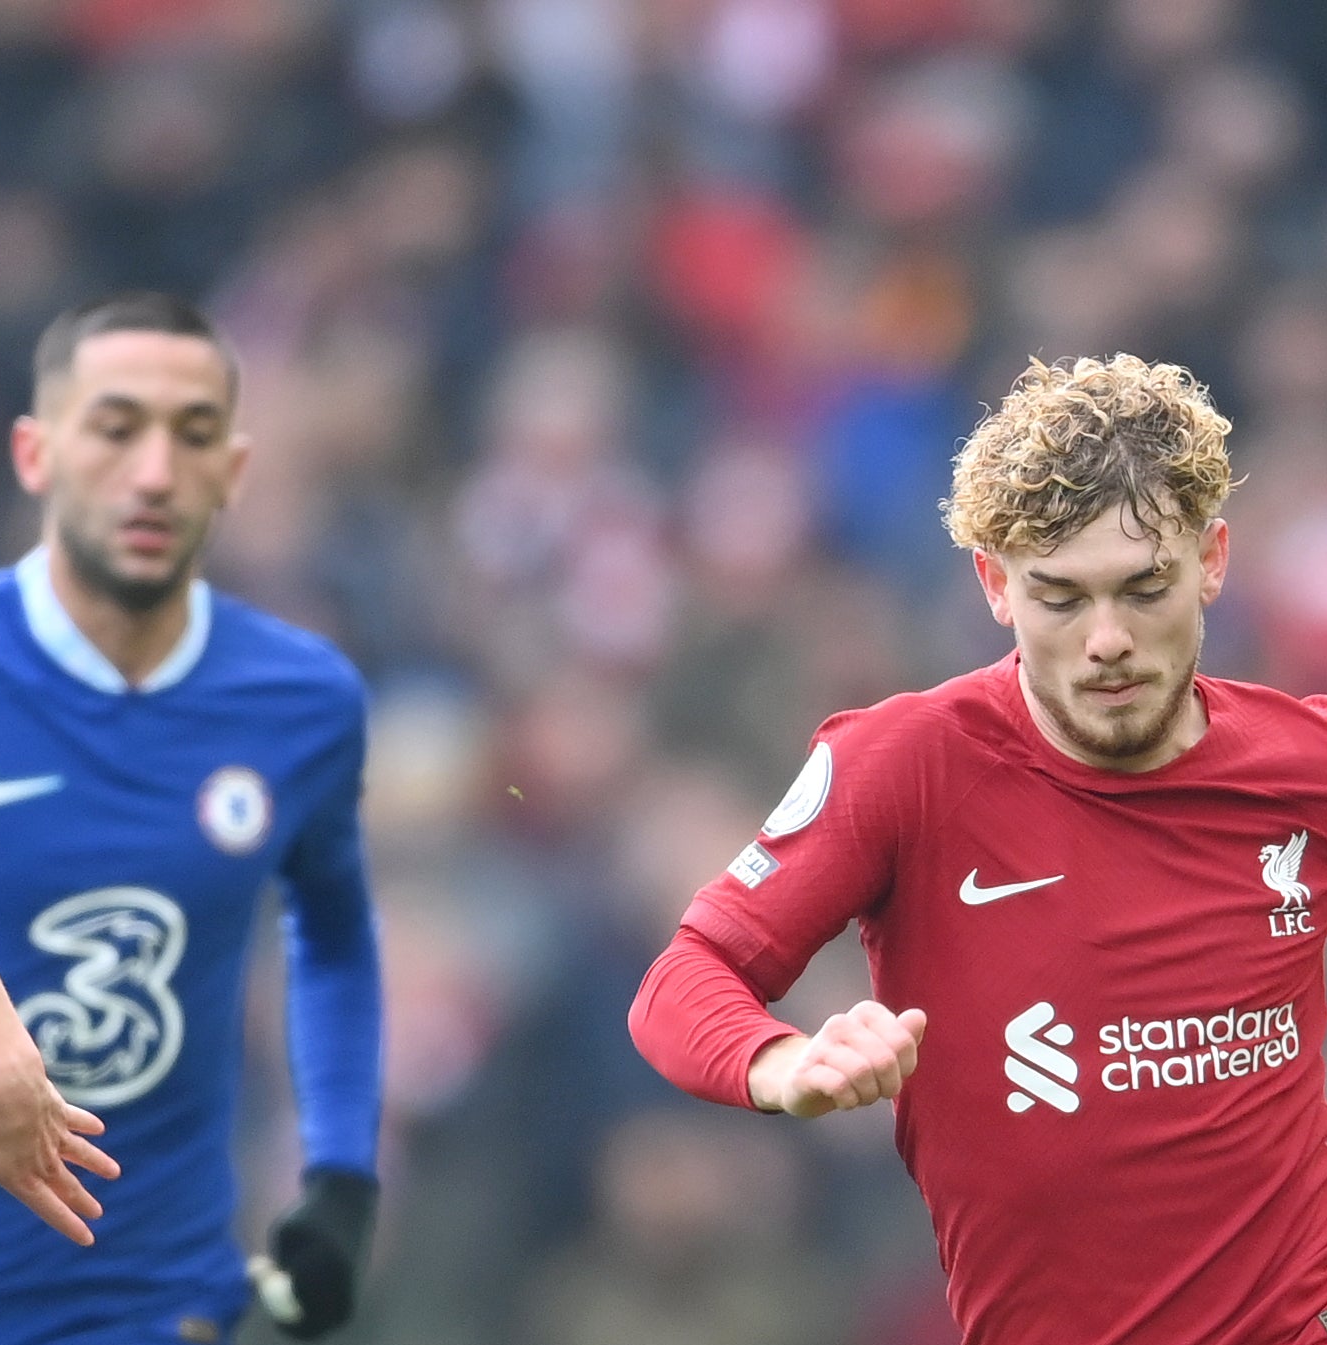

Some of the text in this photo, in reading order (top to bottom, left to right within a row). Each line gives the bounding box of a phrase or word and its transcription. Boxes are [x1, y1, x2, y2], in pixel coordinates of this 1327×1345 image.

[1268, 911, 1316, 937] L.F.C.
[17, 886, 188, 1108] 3
[1098, 1001, 1297, 1055] standard
[1101, 1023, 1300, 1092] chartered
